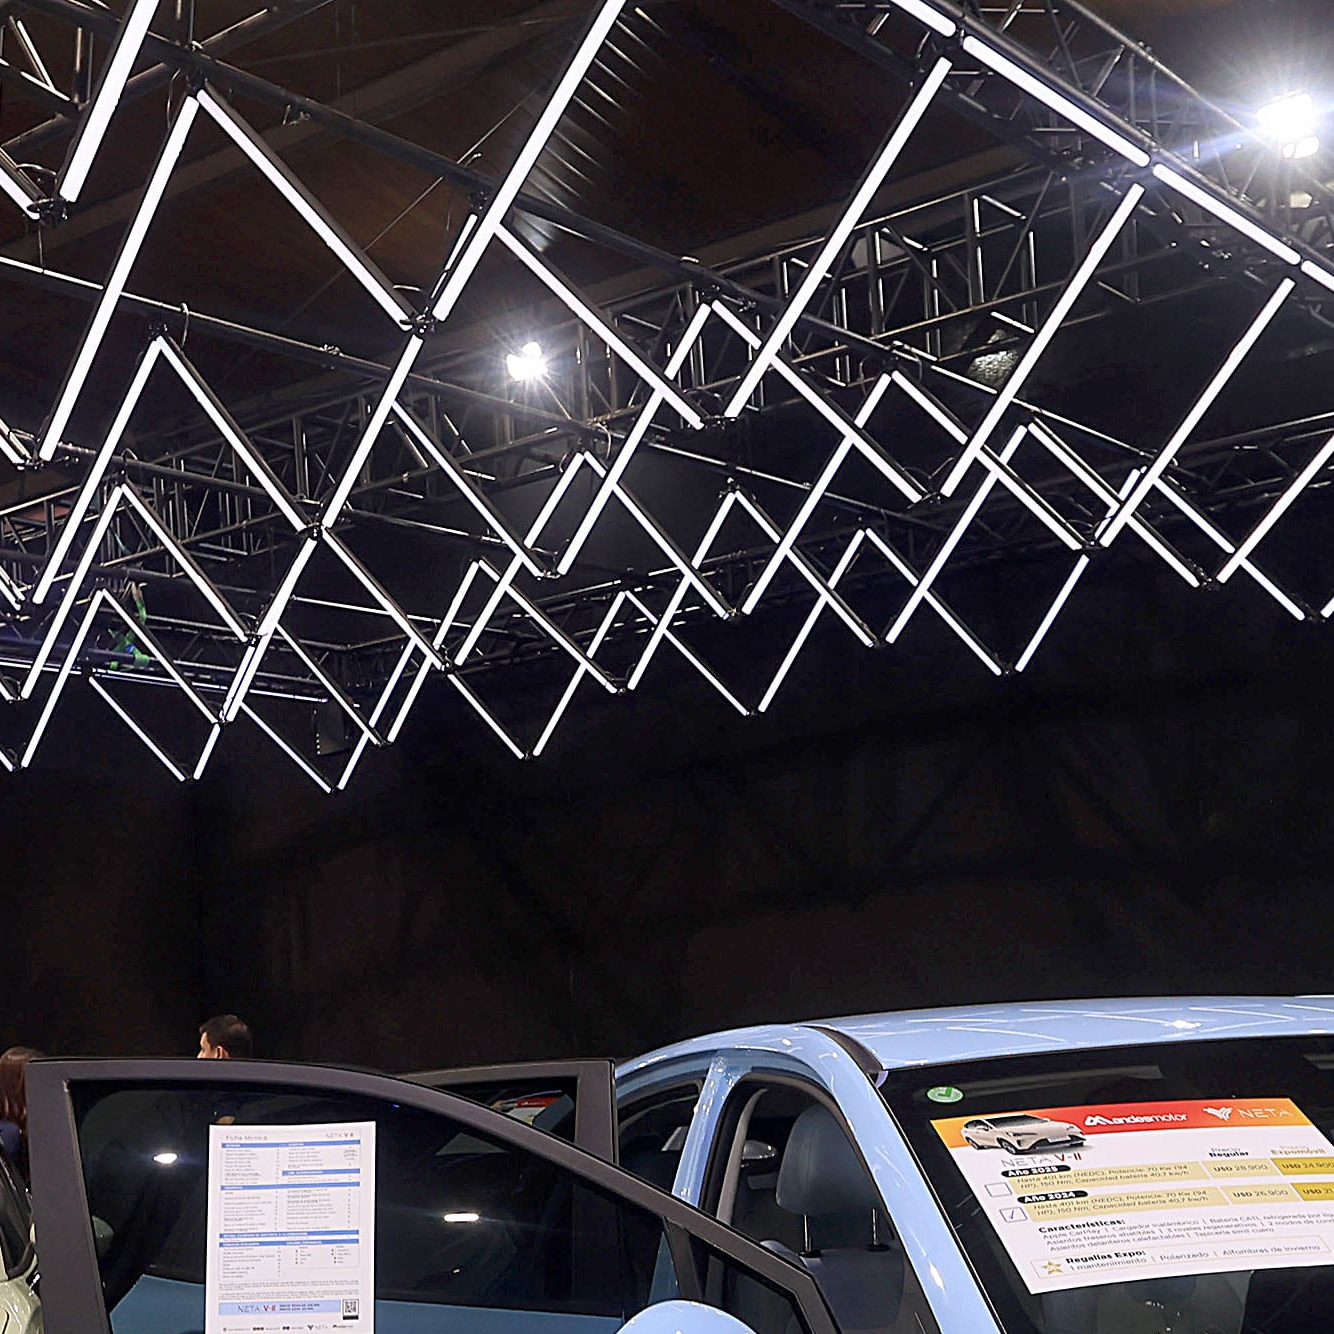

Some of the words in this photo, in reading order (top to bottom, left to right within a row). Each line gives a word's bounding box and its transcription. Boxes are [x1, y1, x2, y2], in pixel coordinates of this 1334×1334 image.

[1237, 1108, 1293, 1118] NETA
[1209, 1150, 1249, 1159] Regular
[1001, 1155, 1053, 1168] NETA
[1007, 1168, 1030, 1177] Año
[1024, 1193, 1046, 1203] Año
[1048, 1191, 1076, 1200] 2024
[1233, 1190, 1253, 1198] USD
[1042, 1231, 1068, 1241] Apple
[1076, 1256, 1147, 1271] mantenimiento
[1159, 1250, 1209, 1262] Polarizado
[1222, 1246, 1269, 1256] Alfombras
[1270, 1245, 1283, 1253] de
[1283, 1243, 1321, 1252] invierno
